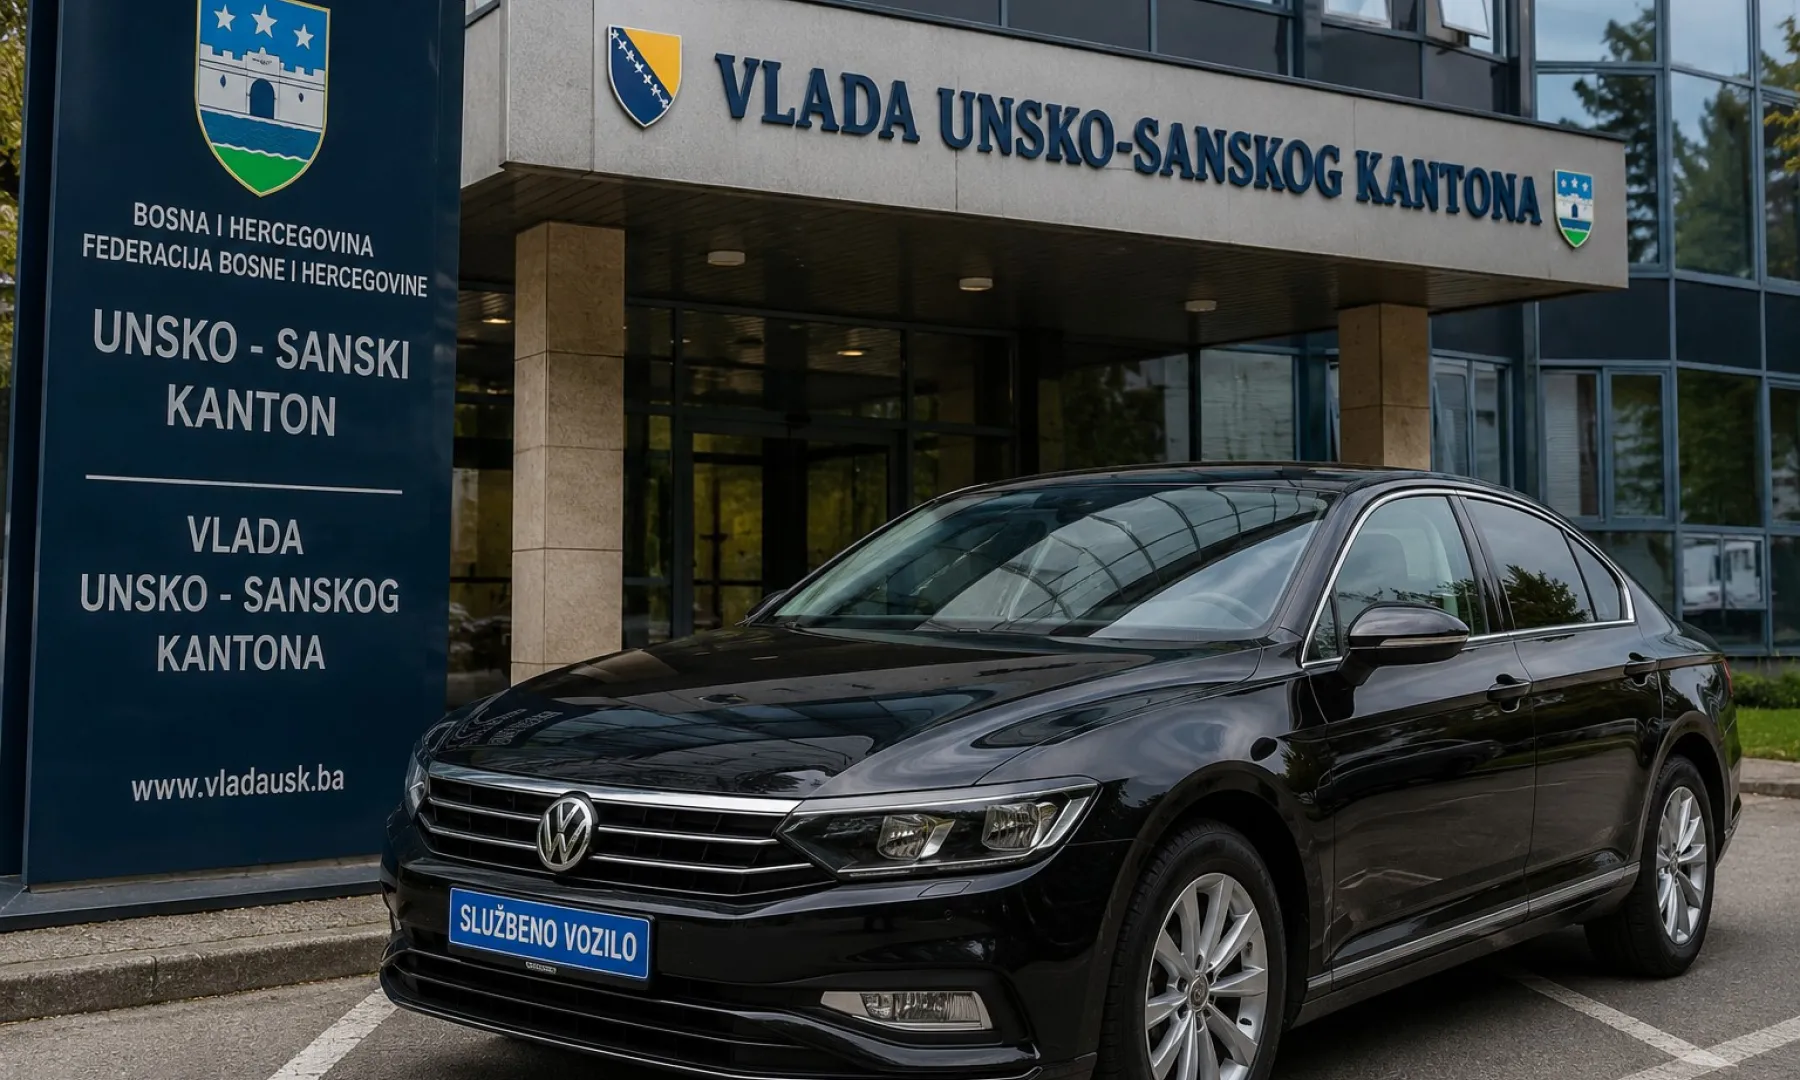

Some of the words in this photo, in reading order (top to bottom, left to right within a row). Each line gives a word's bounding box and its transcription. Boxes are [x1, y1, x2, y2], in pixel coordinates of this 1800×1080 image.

[714, 53, 921, 145] VLADA
[936, 87, 1344, 199] UNSKO-SANSKOG
[1355, 149, 1543, 226] KANTONA
[133, 201, 211, 235] BOSNA
[217, 213, 222, 237] I
[229, 215, 374, 258] HERCEGOVINA
[82, 233, 213, 273] FEDERACIJA
[219, 250, 286, 281] BOSNE
[291, 259, 296, 282] I
[301, 261, 428, 298] HERCEGOVINE
[93, 308, 238, 364] UNSKO
[275, 327, 410, 380] SANSKI
[167, 383, 336, 437] KANTON
[187, 515, 304, 555] VLADA
[80, 573, 208, 613] UNSKO
[243, 575, 399, 614] SANSKOG
[157, 634, 326, 672] KANTONA
[131, 763, 345, 802] www.vladausk.ba
[539, 799, 591, 870] VW
[460, 904, 558, 949] SLUŽBENO
[563, 921, 637, 962] VOZILO
